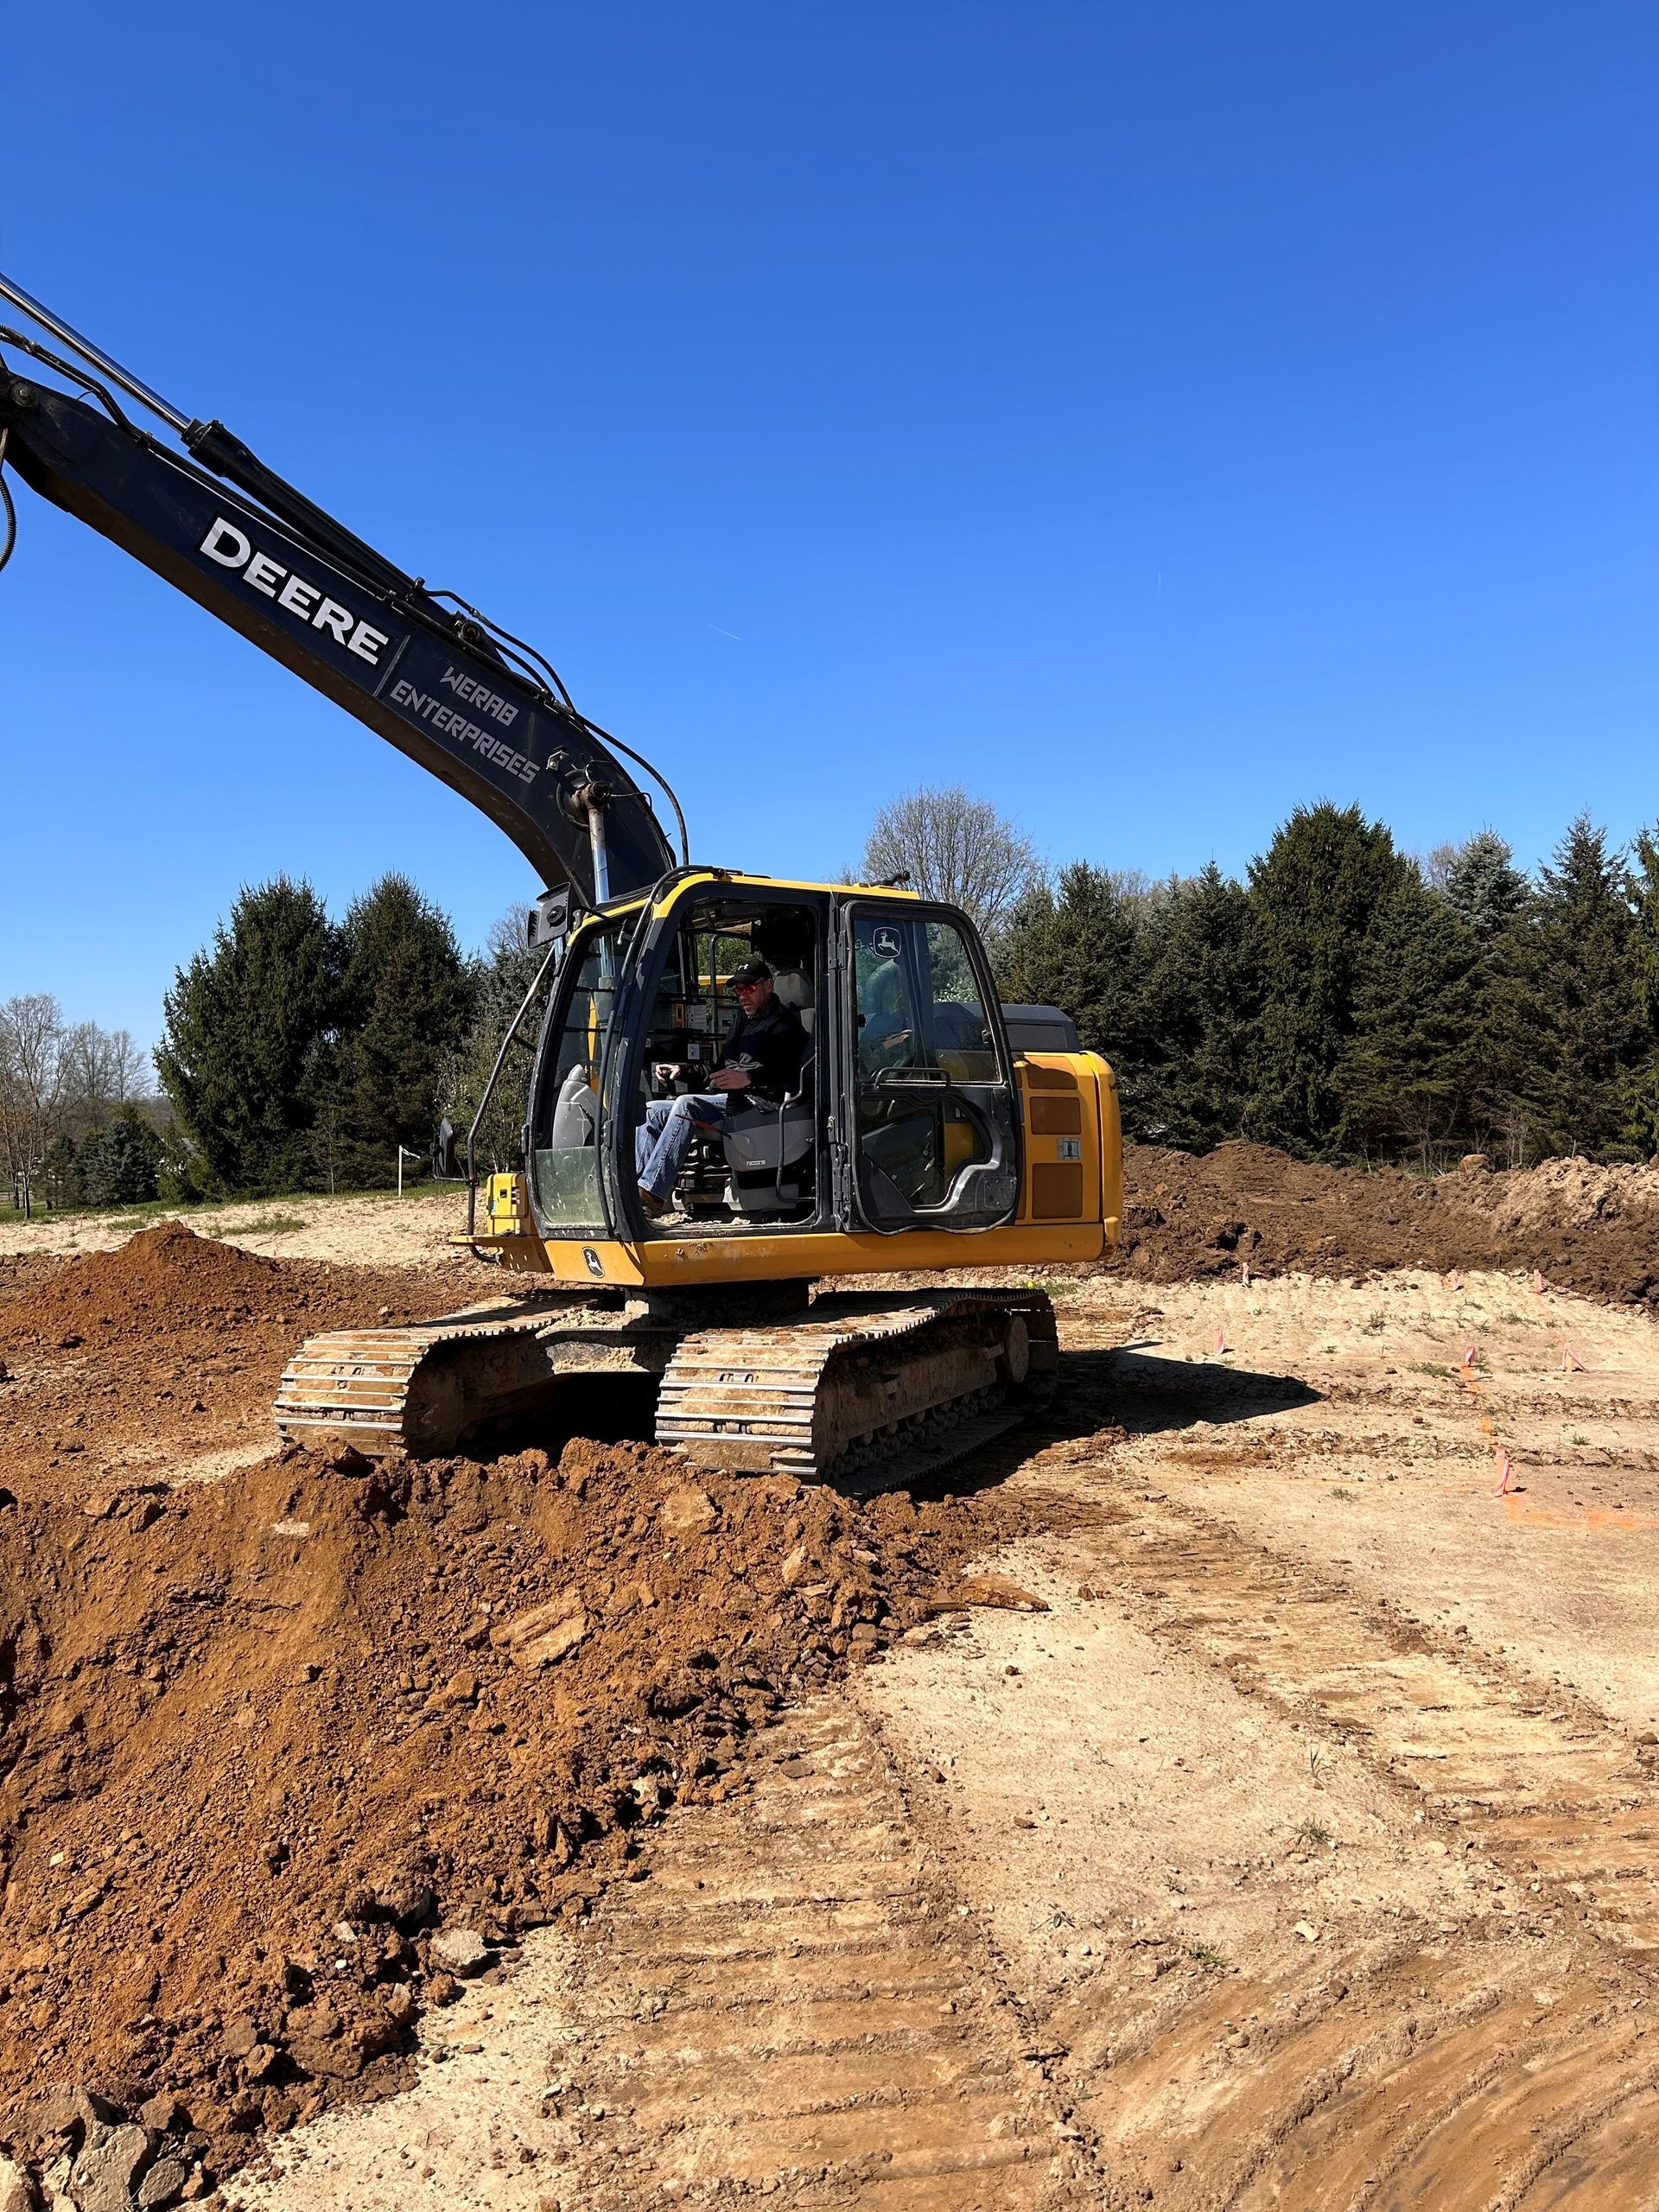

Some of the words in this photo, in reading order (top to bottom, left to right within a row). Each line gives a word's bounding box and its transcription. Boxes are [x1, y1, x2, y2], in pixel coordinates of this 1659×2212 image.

[200, 517, 389, 665] DEERE
[390, 679, 540, 784] ENTERPRISES
[440, 666, 518, 727] WERAB
